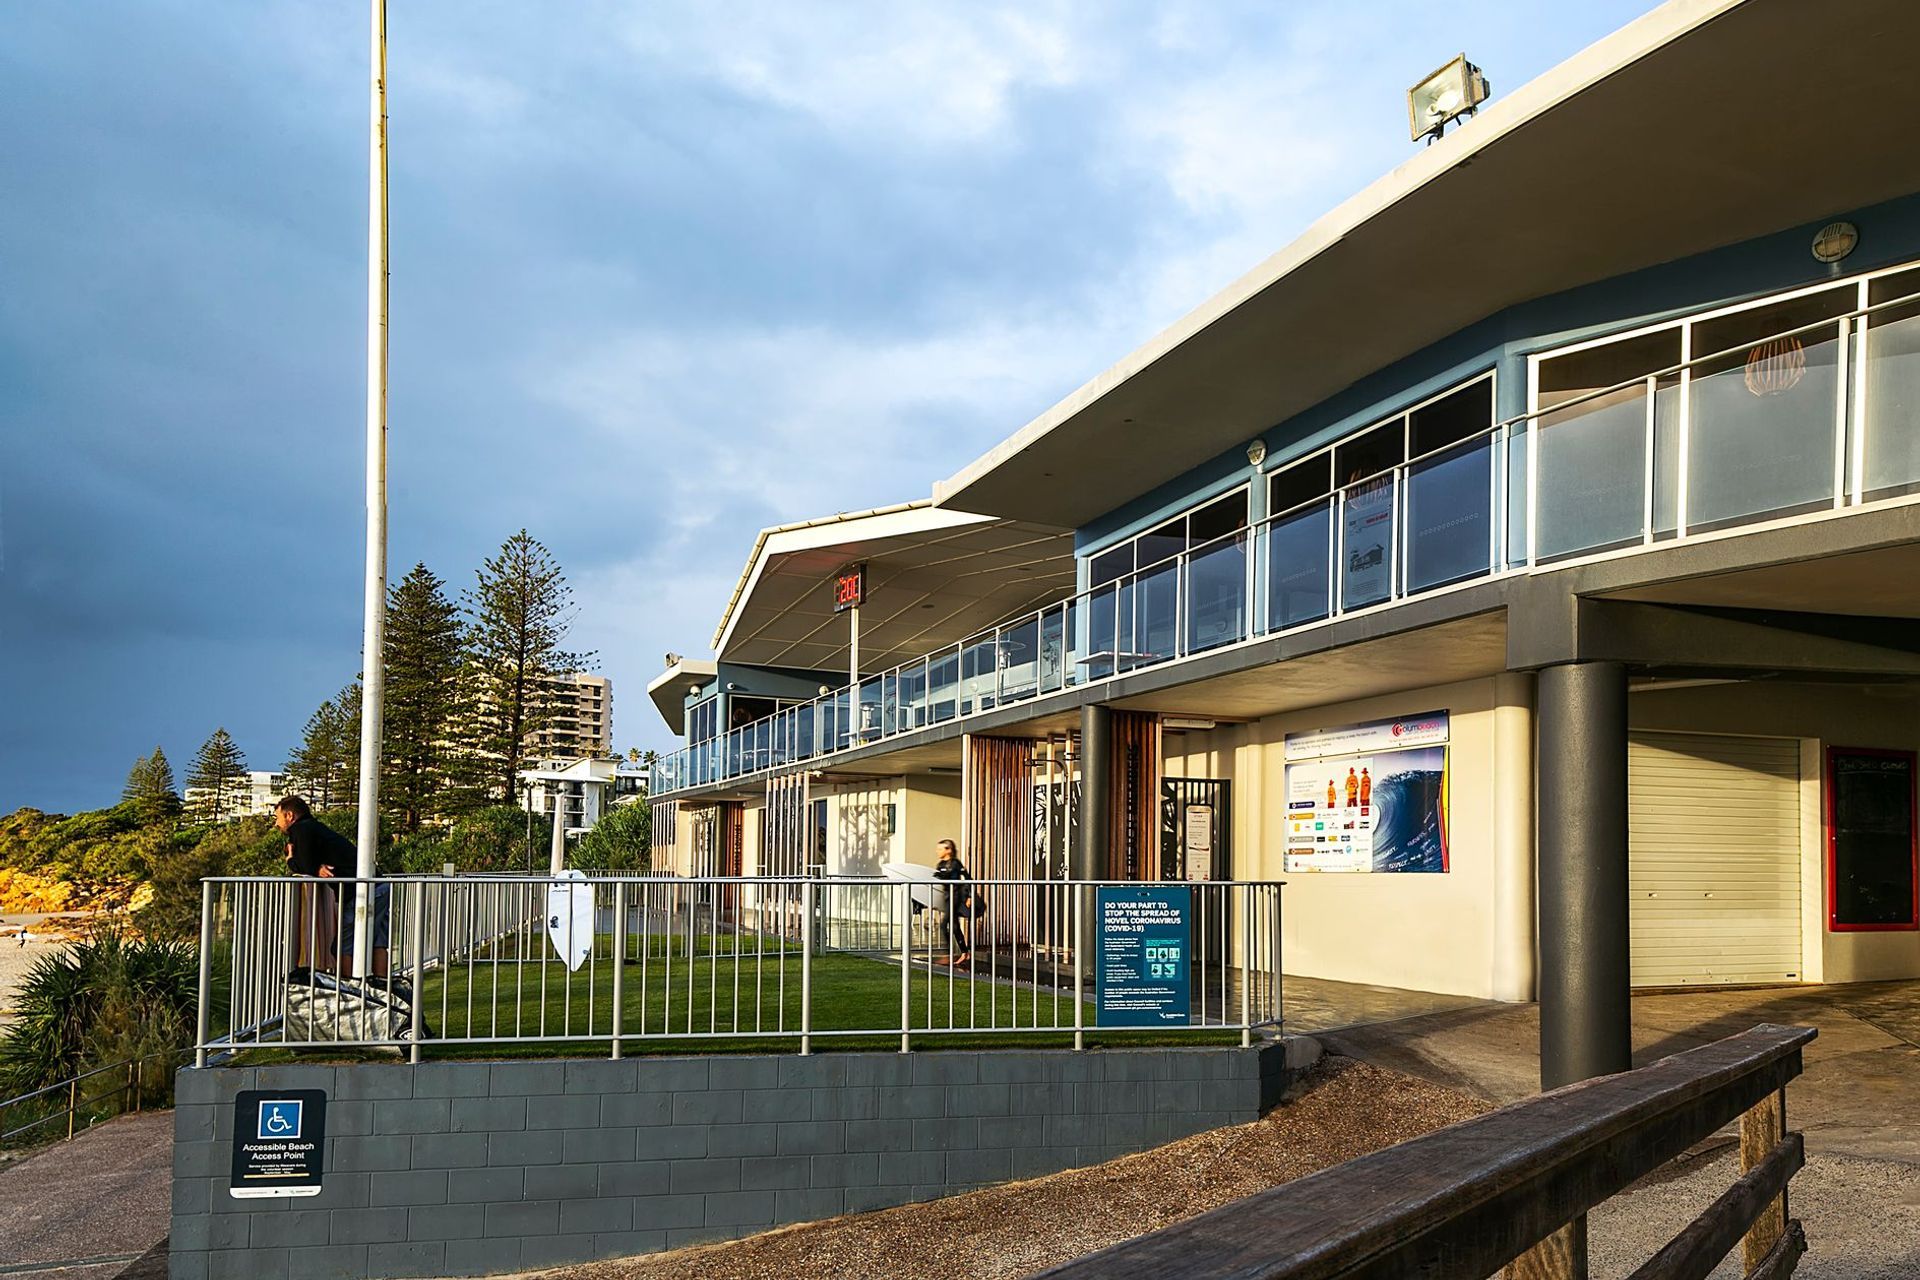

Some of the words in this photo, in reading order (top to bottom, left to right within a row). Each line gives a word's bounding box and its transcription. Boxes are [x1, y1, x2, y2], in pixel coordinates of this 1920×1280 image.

[242, 1143, 287, 1151] Accessible
[288, 1142, 315, 1150] Beach
[251, 1152, 282, 1160] Access
[283, 1151, 305, 1159] Point
